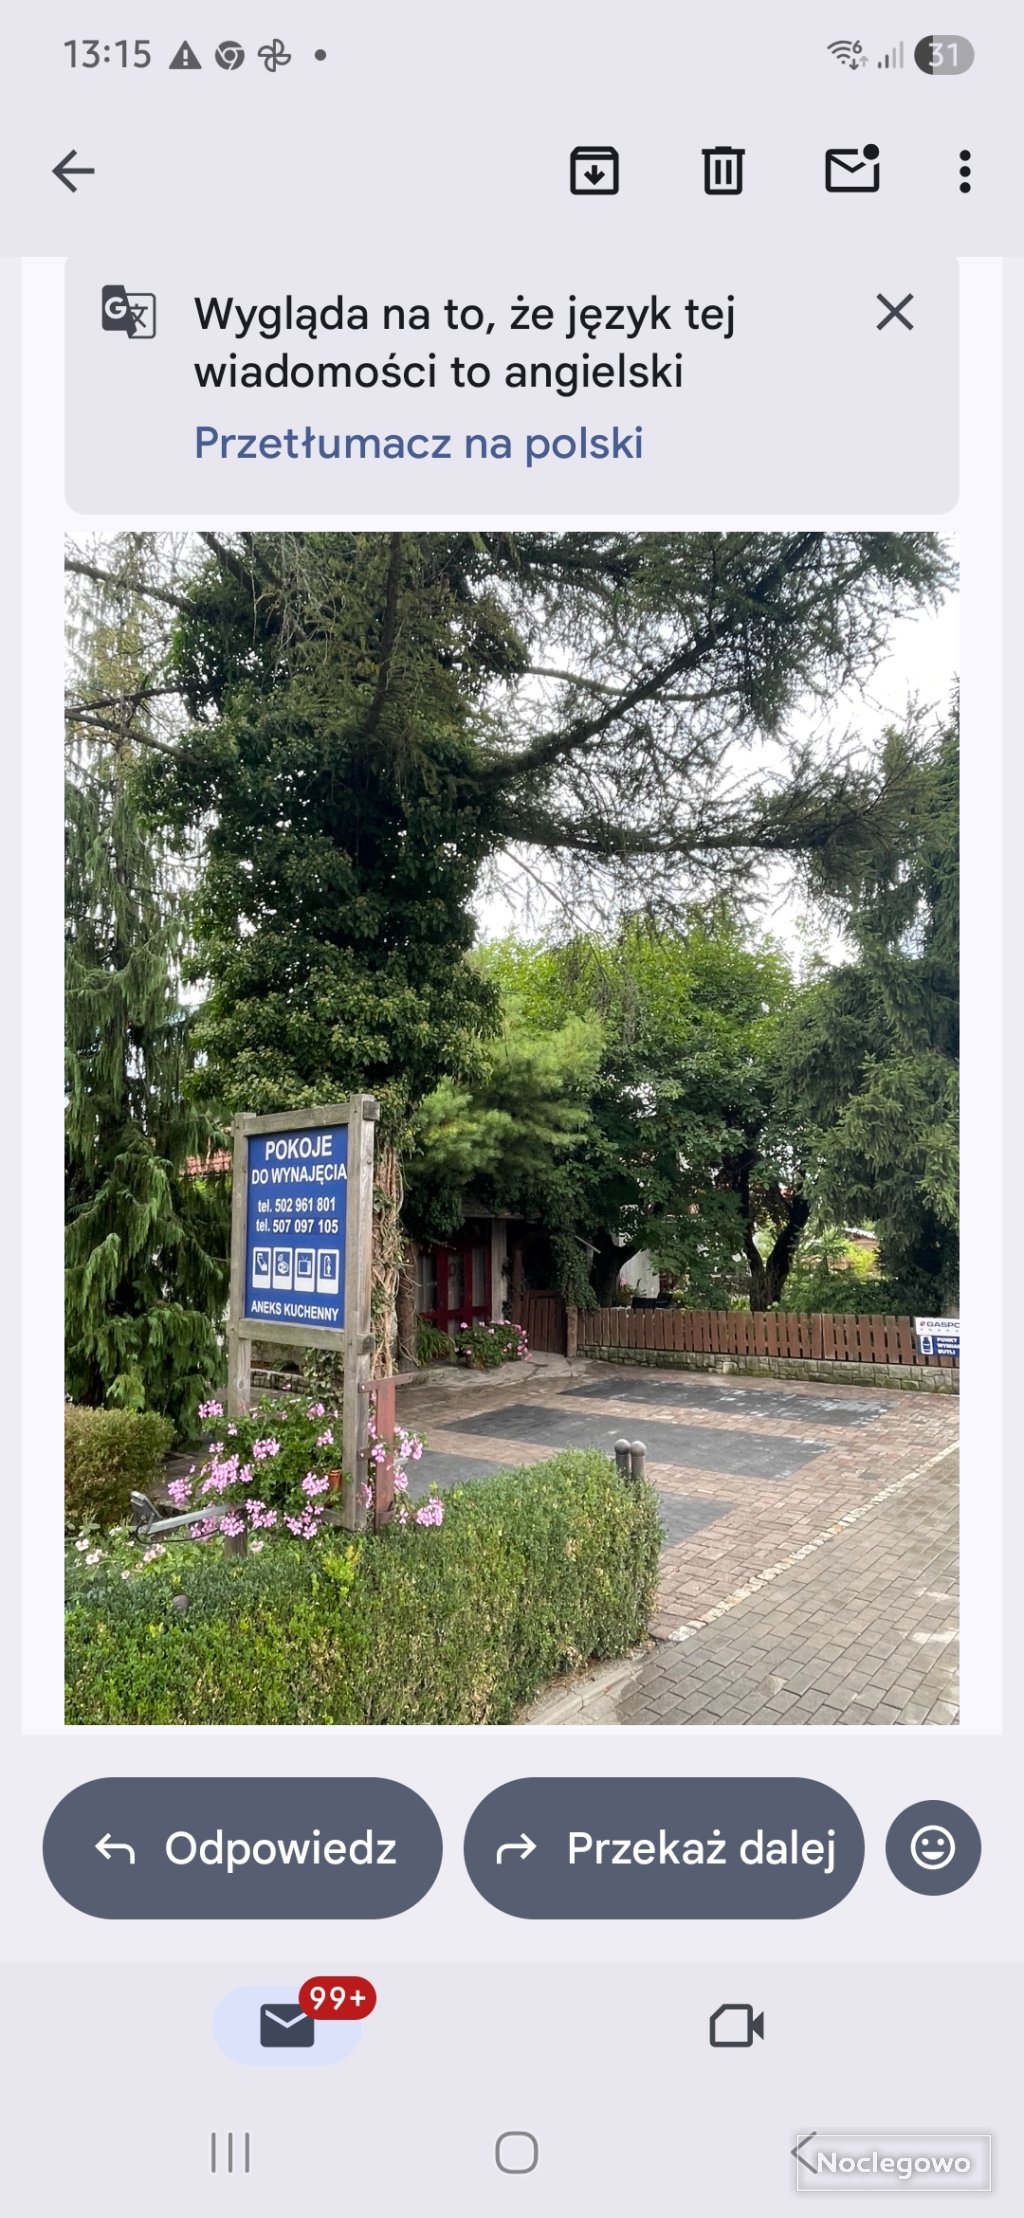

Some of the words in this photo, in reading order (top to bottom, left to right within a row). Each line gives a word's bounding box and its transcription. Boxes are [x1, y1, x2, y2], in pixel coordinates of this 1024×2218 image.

[64, 40, 151, 68] 13:15
[928, 42, 958, 67] 31
[194, 297, 367, 339] Wygląda
[384, 305, 429, 330] na
[444, 299, 495, 335] to,
[511, 295, 554, 330] że
[566, 297, 671, 339] język
[685, 297, 734, 339] tej
[194, 352, 436, 388] wiadomości
[450, 357, 490, 388] to
[505, 352, 682, 397] angielski
[197, 426, 451, 459] Przetłumacz
[466, 435, 511, 459] na
[527, 426, 642, 467] polski
[265, 1135, 333, 1161] POKOJE
[251, 1168, 269, 1185] DO
[271, 1163, 348, 1185] WYNAJĘCIA
[257, 1199, 272, 1213] tel.
[275, 1198, 293, 1213] 502
[295, 1197, 313, 1212] 961
[317, 1197, 335, 1211] 801
[256, 1219, 271, 1232] tel.
[273, 1219, 291, 1233] 507
[294, 1219, 313, 1233] 097
[318, 1219, 338, 1233] 105
[251, 1300, 282, 1316] ANEKS
[283, 1303, 339, 1321] KUCHENNY
[166, 1829, 396, 1873] Odpowiedz
[569, 1829, 726, 1866] Przekaż
[740, 1829, 835, 1874] dalej
[310, 1986, 365, 2011] 99+
